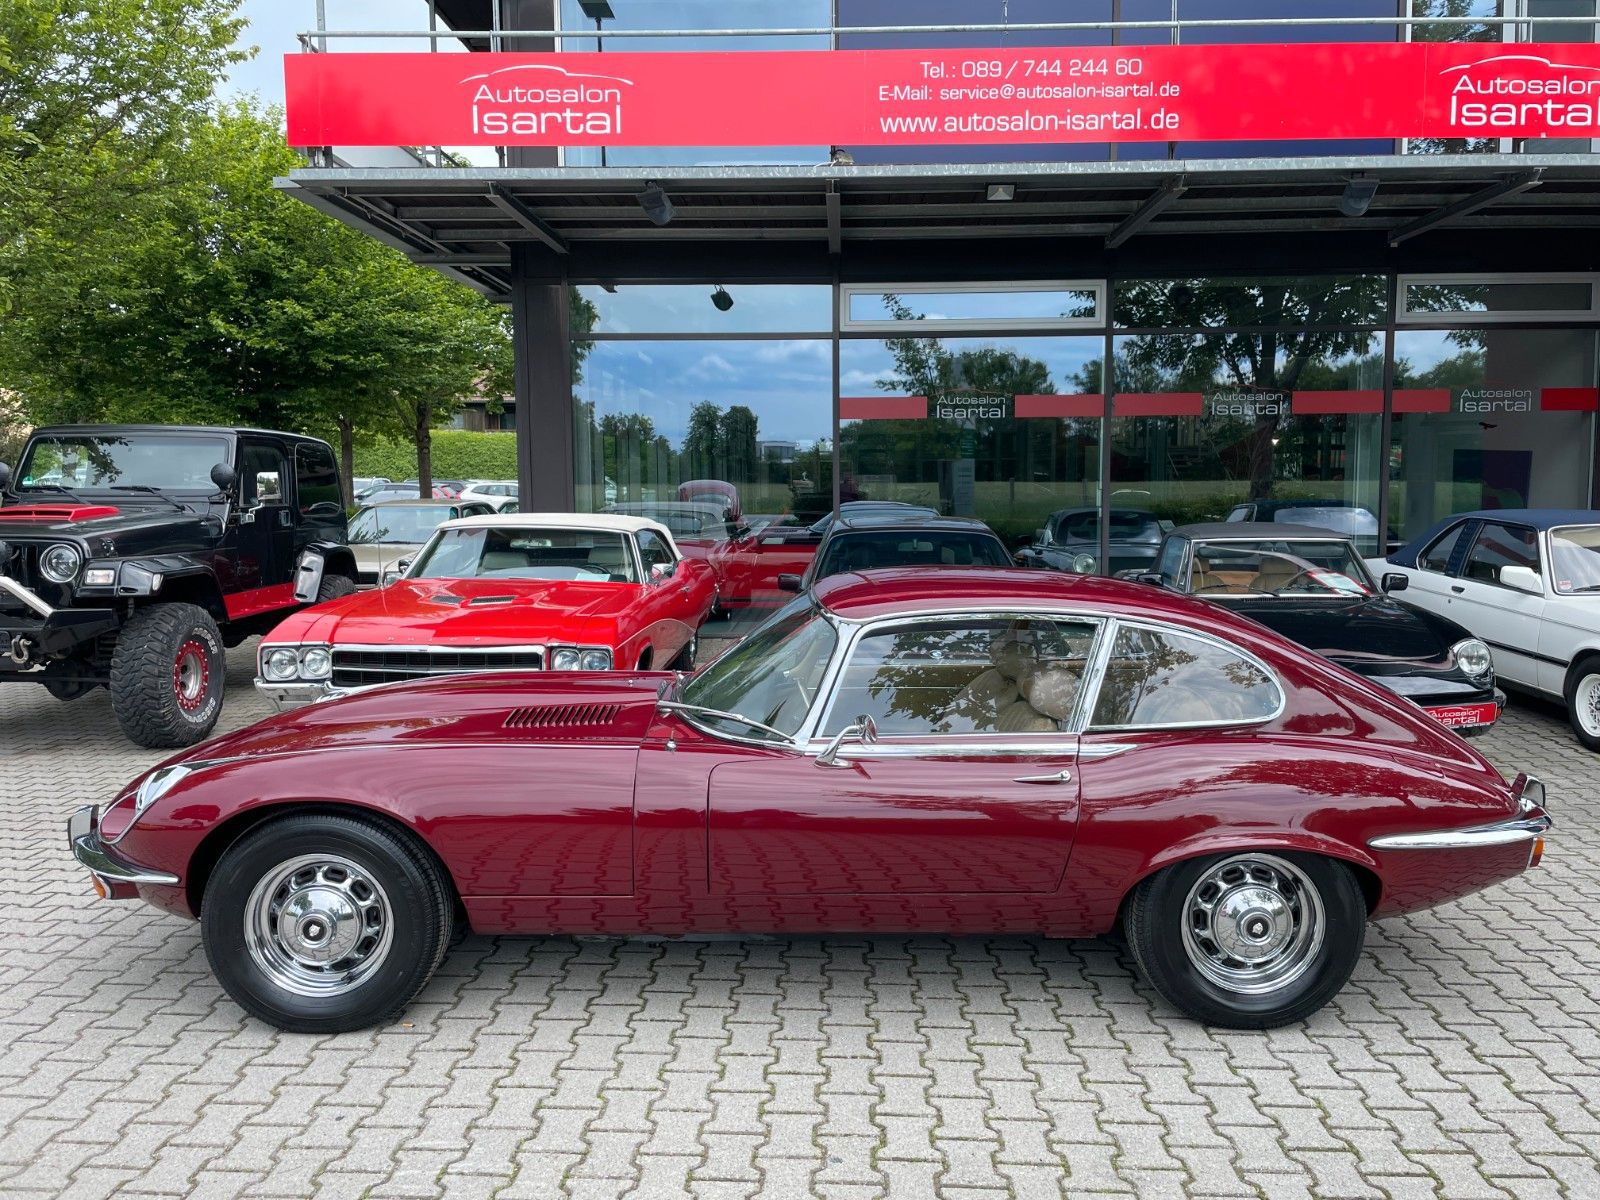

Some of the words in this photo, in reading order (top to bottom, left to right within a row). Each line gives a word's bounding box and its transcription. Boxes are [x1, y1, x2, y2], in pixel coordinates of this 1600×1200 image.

[920, 61, 956, 79] Tel.:
[961, 60, 1002, 78] 089
[1004, 60, 1019, 80] /
[1023, 59, 1062, 77] 744
[1069, 58, 1109, 76] 244
[1115, 57, 1143, 76] 60
[473, 84, 621, 103] Autosalon
[878, 85, 933, 101] E-Mail:
[939, 81, 1180, 99] service@autosalon-isartal.de
[472, 104, 622, 135] Isartal
[879, 107, 1179, 133] www.autosalon-isartal.de
[937, 395, 1006, 405] Autosalon
[1212, 391, 1283, 401] Autosalon
[1460, 388, 1532, 398] Autosalon
[936, 405, 1006, 419] Isartal
[1211, 401, 1283, 416] Isartal
[1459, 398, 1532, 413] Isartal
[1437, 715, 1480, 726] artal
